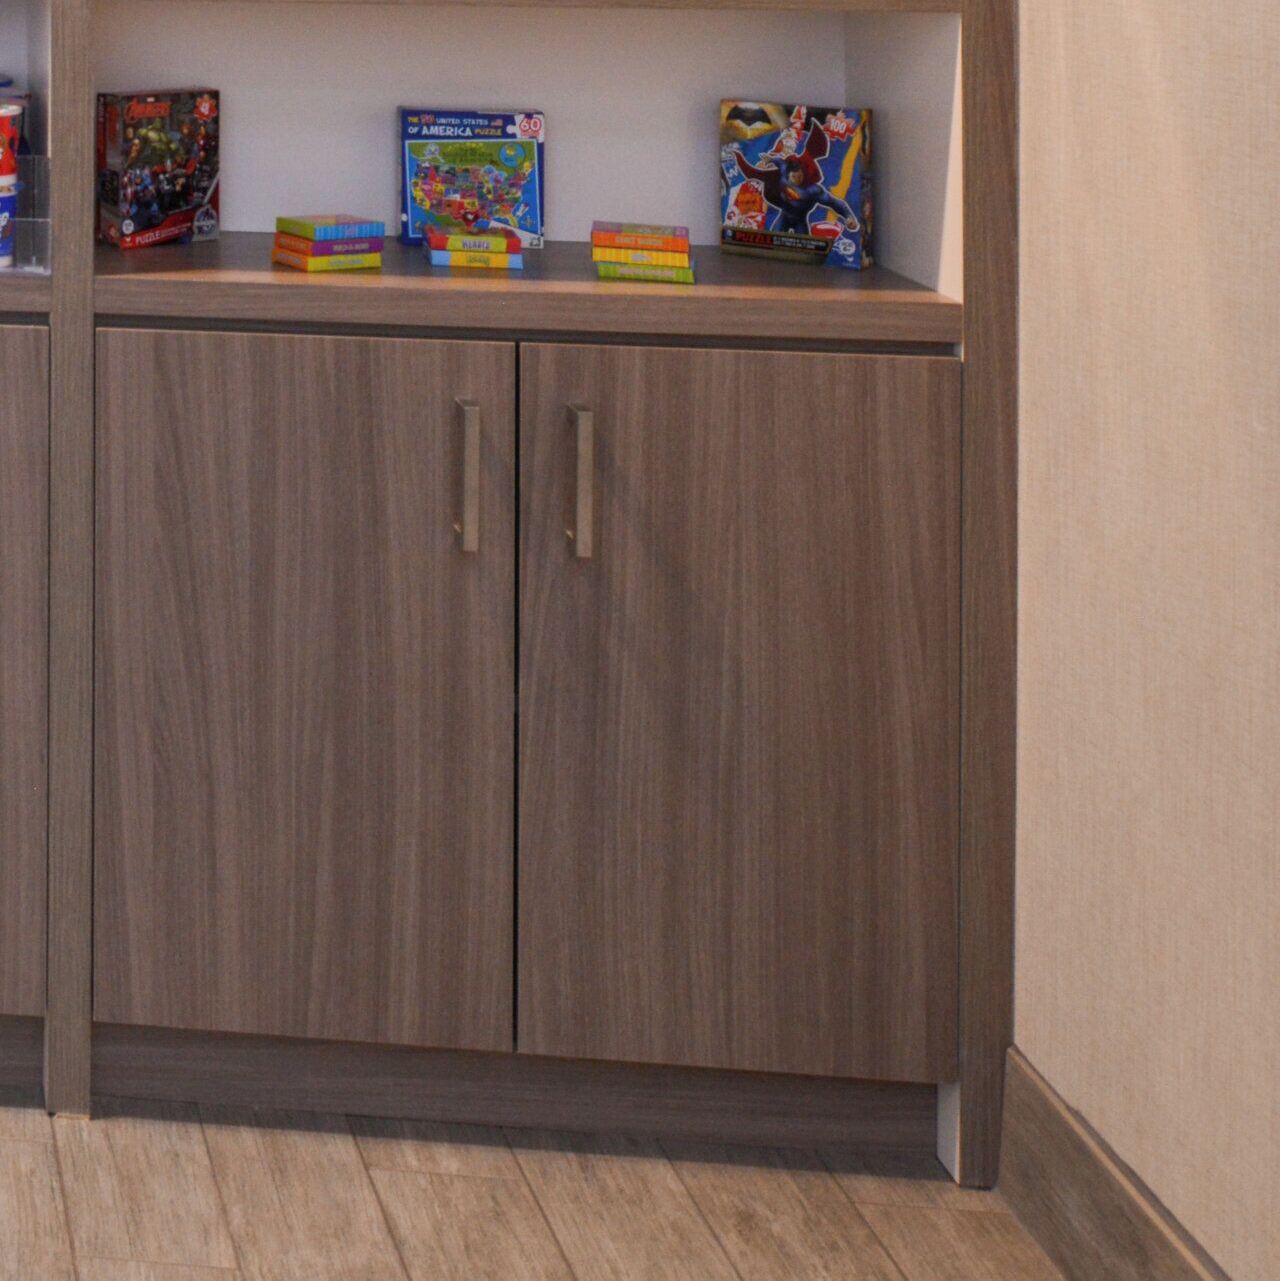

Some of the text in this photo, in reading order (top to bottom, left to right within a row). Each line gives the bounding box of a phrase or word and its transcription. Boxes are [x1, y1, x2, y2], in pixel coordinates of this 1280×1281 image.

[463, 118, 488, 126] STATES
[519, 118, 540, 132] 60
[421, 125, 473, 137] AMERICA
[135, 231, 161, 245] PUZZLE
